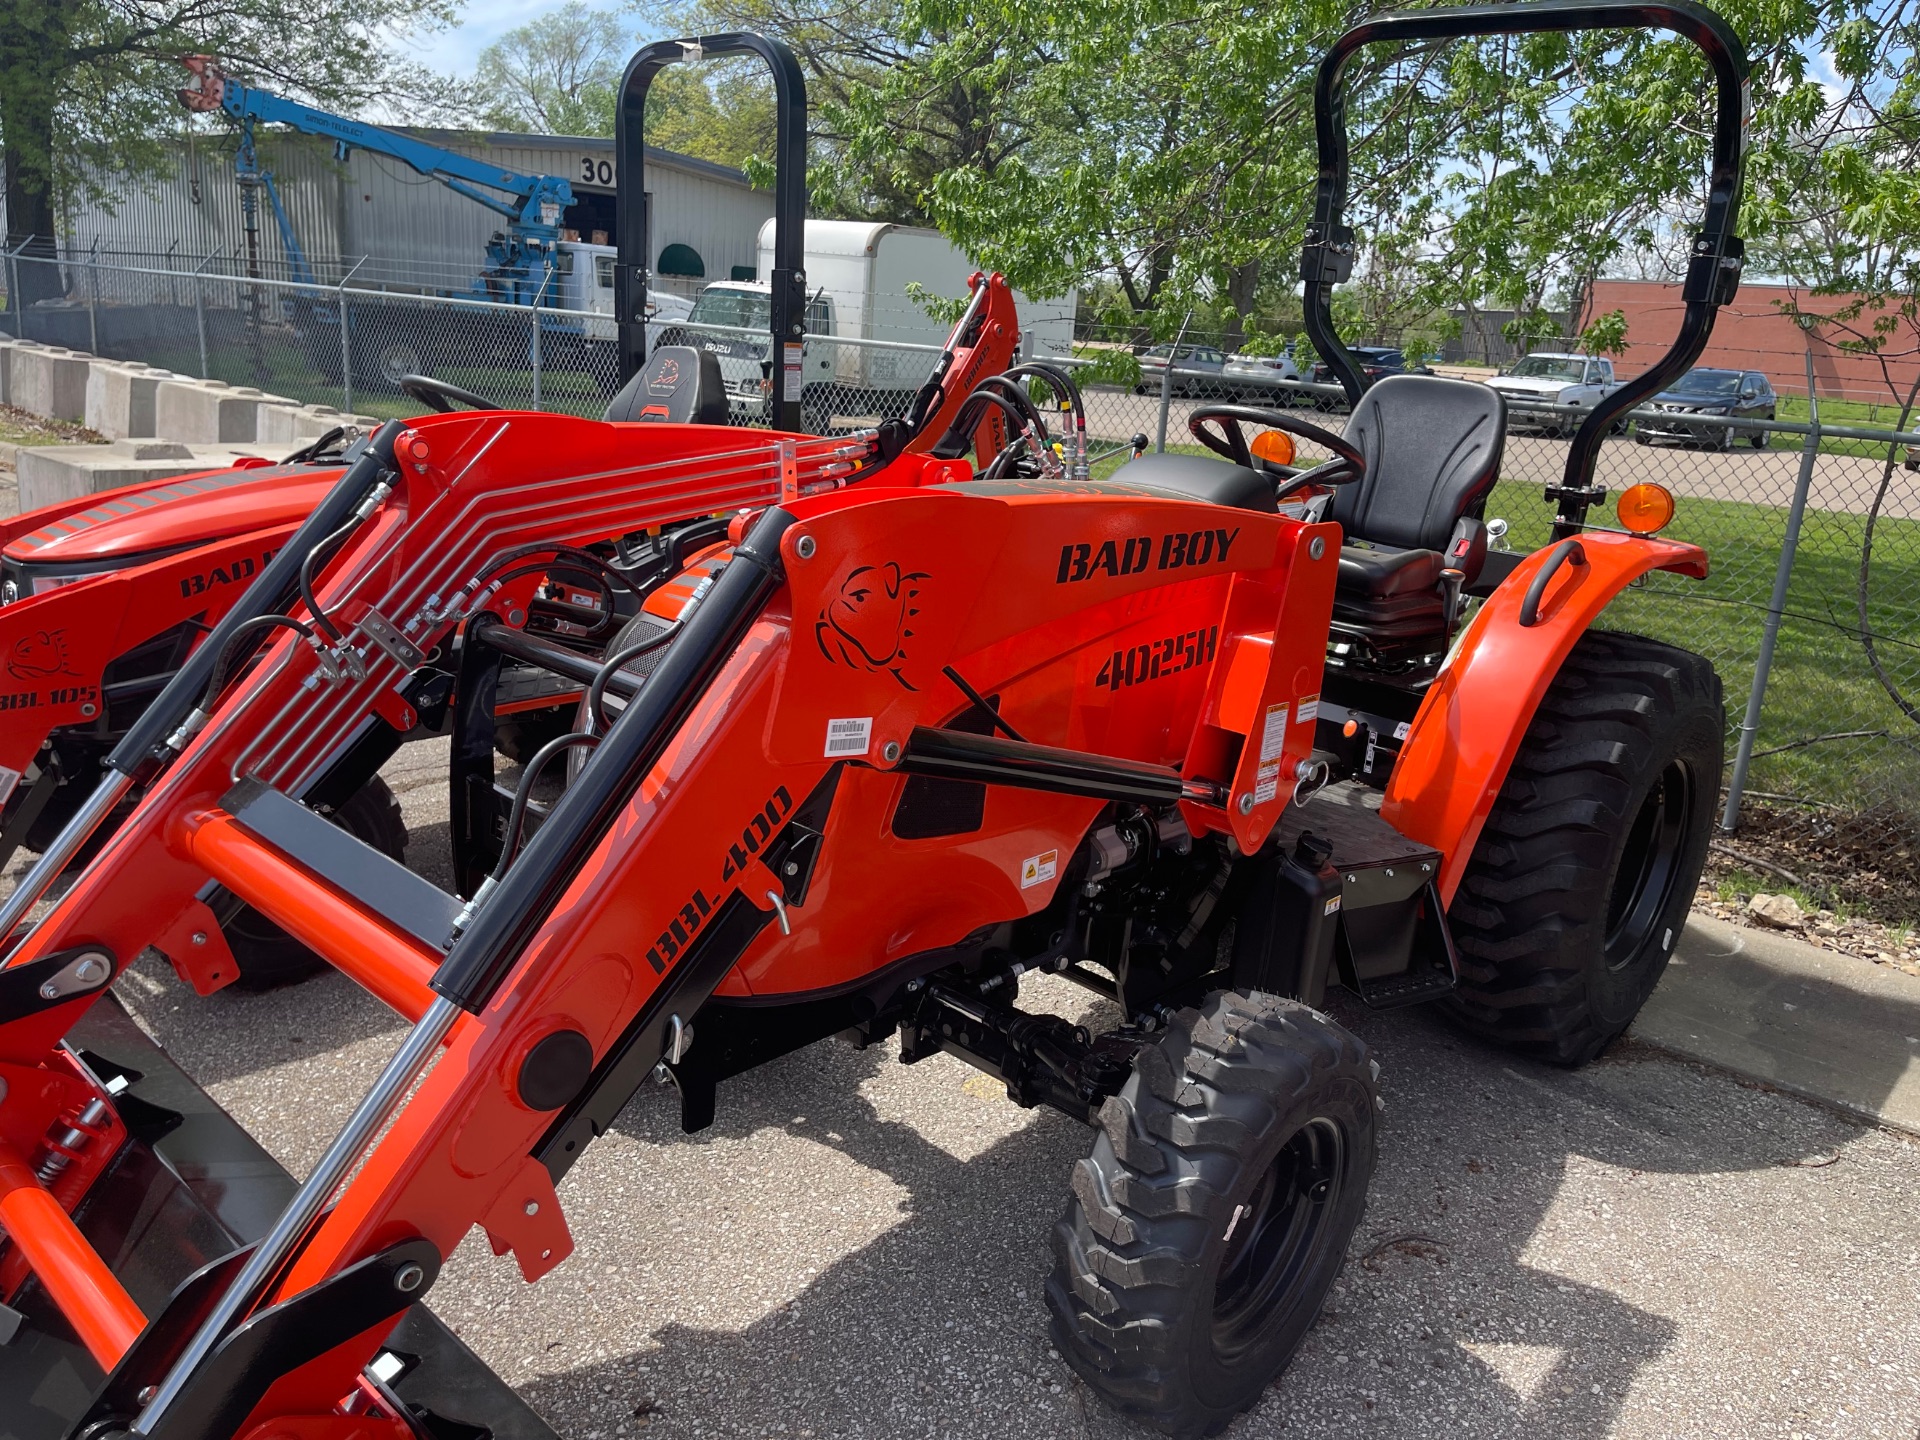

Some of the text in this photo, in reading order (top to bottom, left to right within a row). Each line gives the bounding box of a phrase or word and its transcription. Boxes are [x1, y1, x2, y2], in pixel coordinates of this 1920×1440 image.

[705, 342, 731, 354] ISUZU
[180, 557, 255, 598] BAD
[1056, 527, 1240, 584] BAD BOY
[1095, 625, 1218, 692] 4025H
[50, 685, 97, 705] 105
[645, 785, 793, 976] BBL 400
